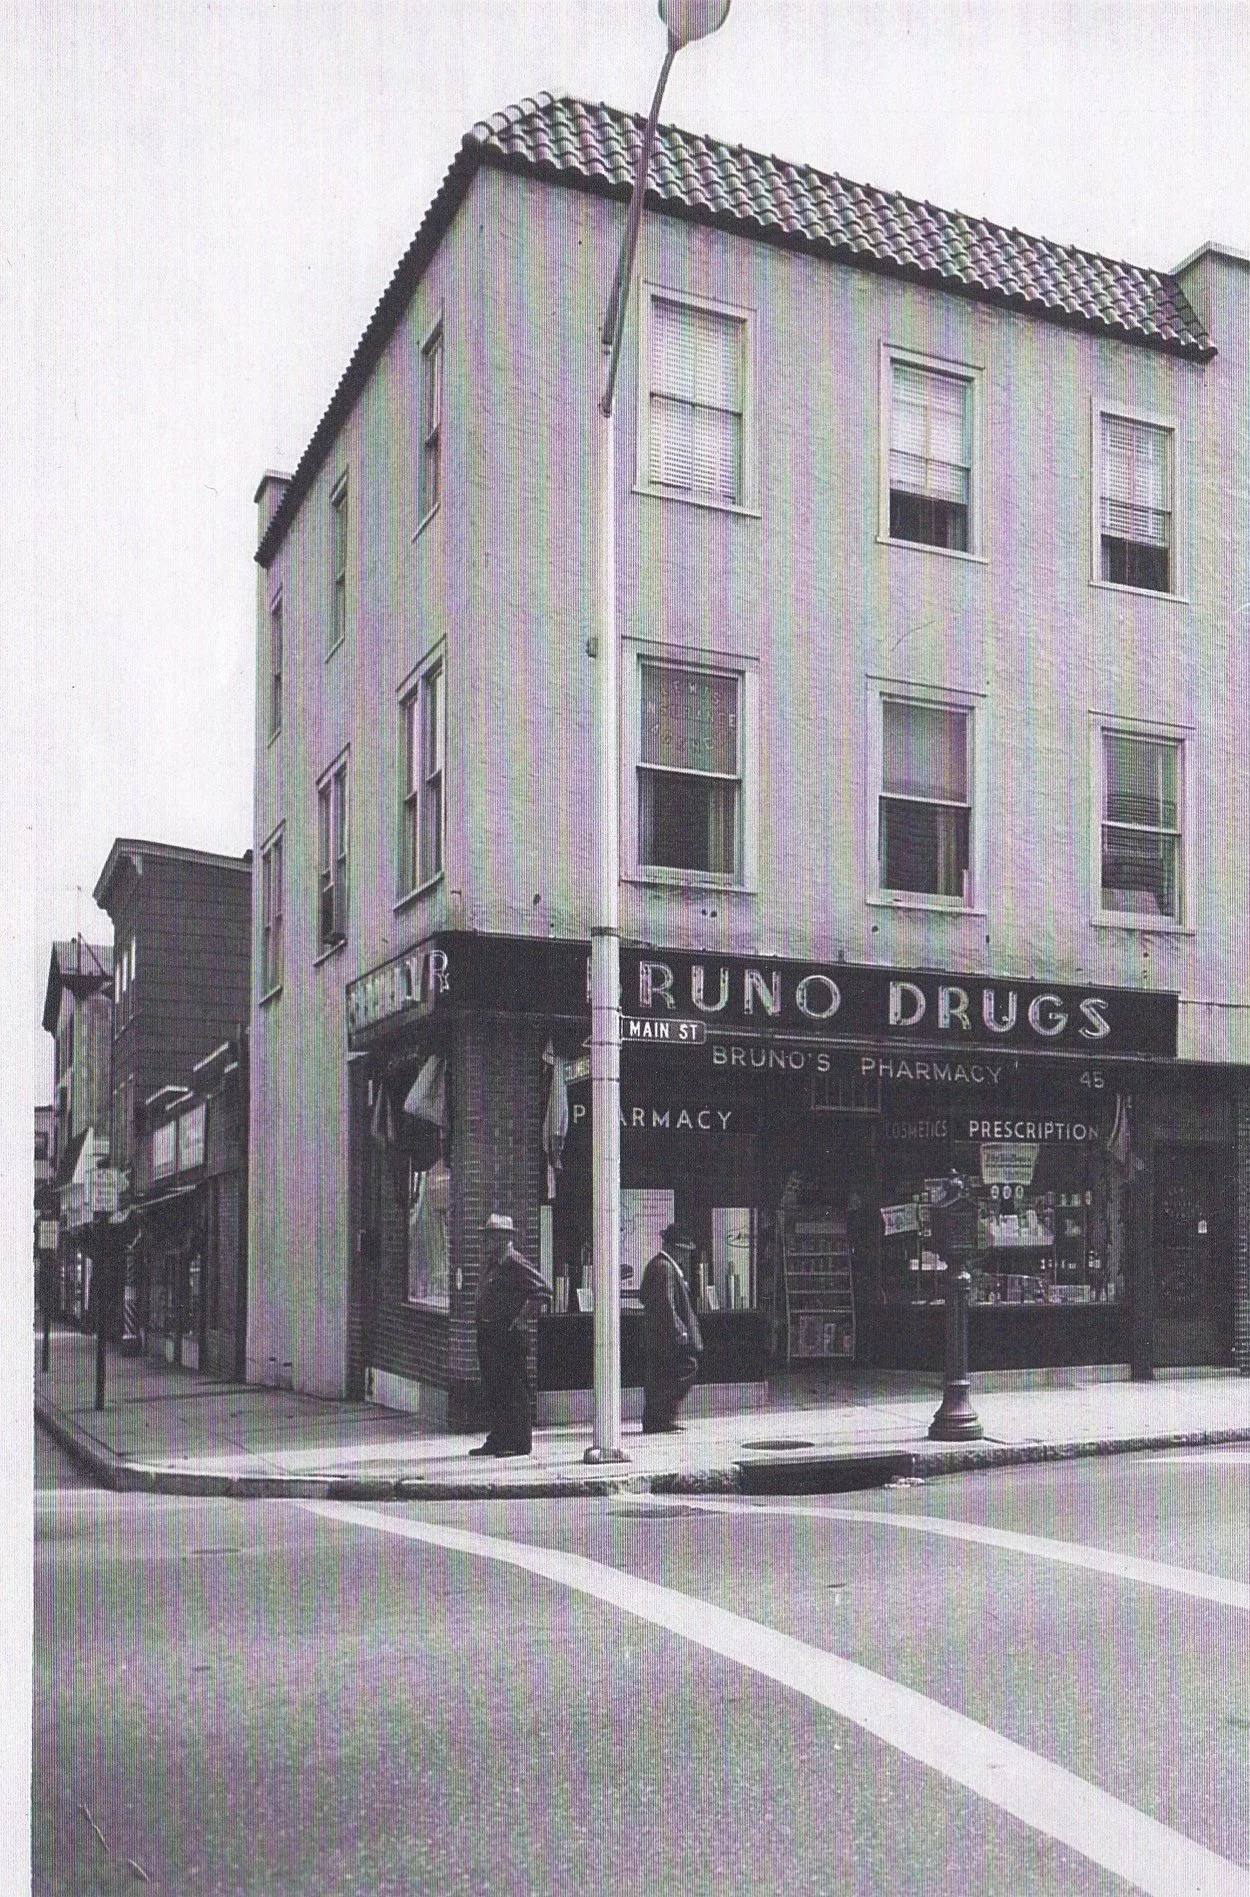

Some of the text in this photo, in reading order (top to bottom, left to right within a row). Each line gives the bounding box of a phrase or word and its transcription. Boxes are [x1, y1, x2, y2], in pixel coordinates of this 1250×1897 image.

[888, 980, 1111, 1040] DRUGS
[629, 1019, 698, 1040] MAIN ST
[712, 1045, 1006, 1084] BRUNO'S PHARMACY
[1079, 1070, 1106, 1089] 45
[572, 1104, 733, 1130] PRMACY
[968, 1119, 1099, 1142] PRESCRIPTION
